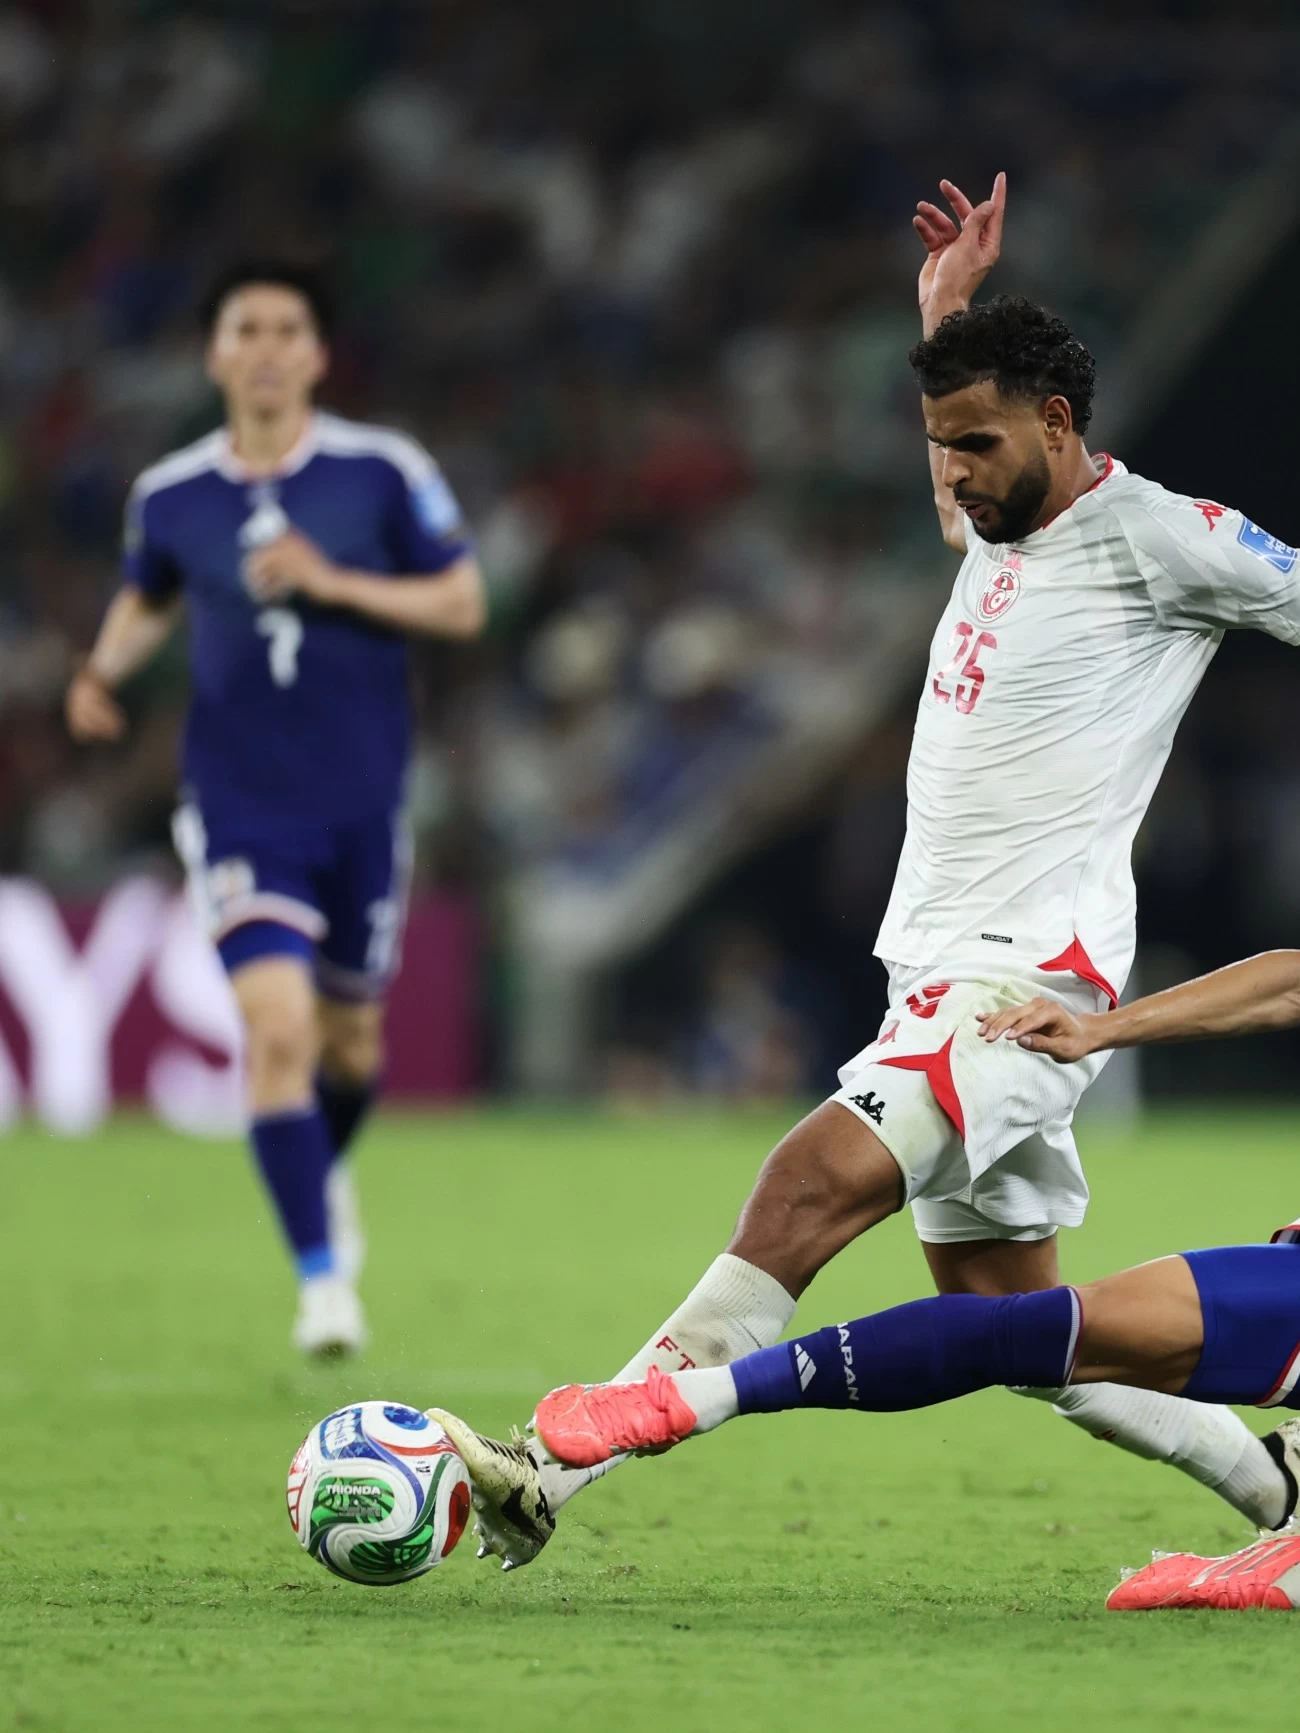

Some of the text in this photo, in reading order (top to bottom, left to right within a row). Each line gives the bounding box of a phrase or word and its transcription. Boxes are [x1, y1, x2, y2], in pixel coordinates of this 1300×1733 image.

[254, 606, 304, 690] 7
[934, 622, 997, 713] 25
[326, 1485, 381, 1496] TRIONDA
